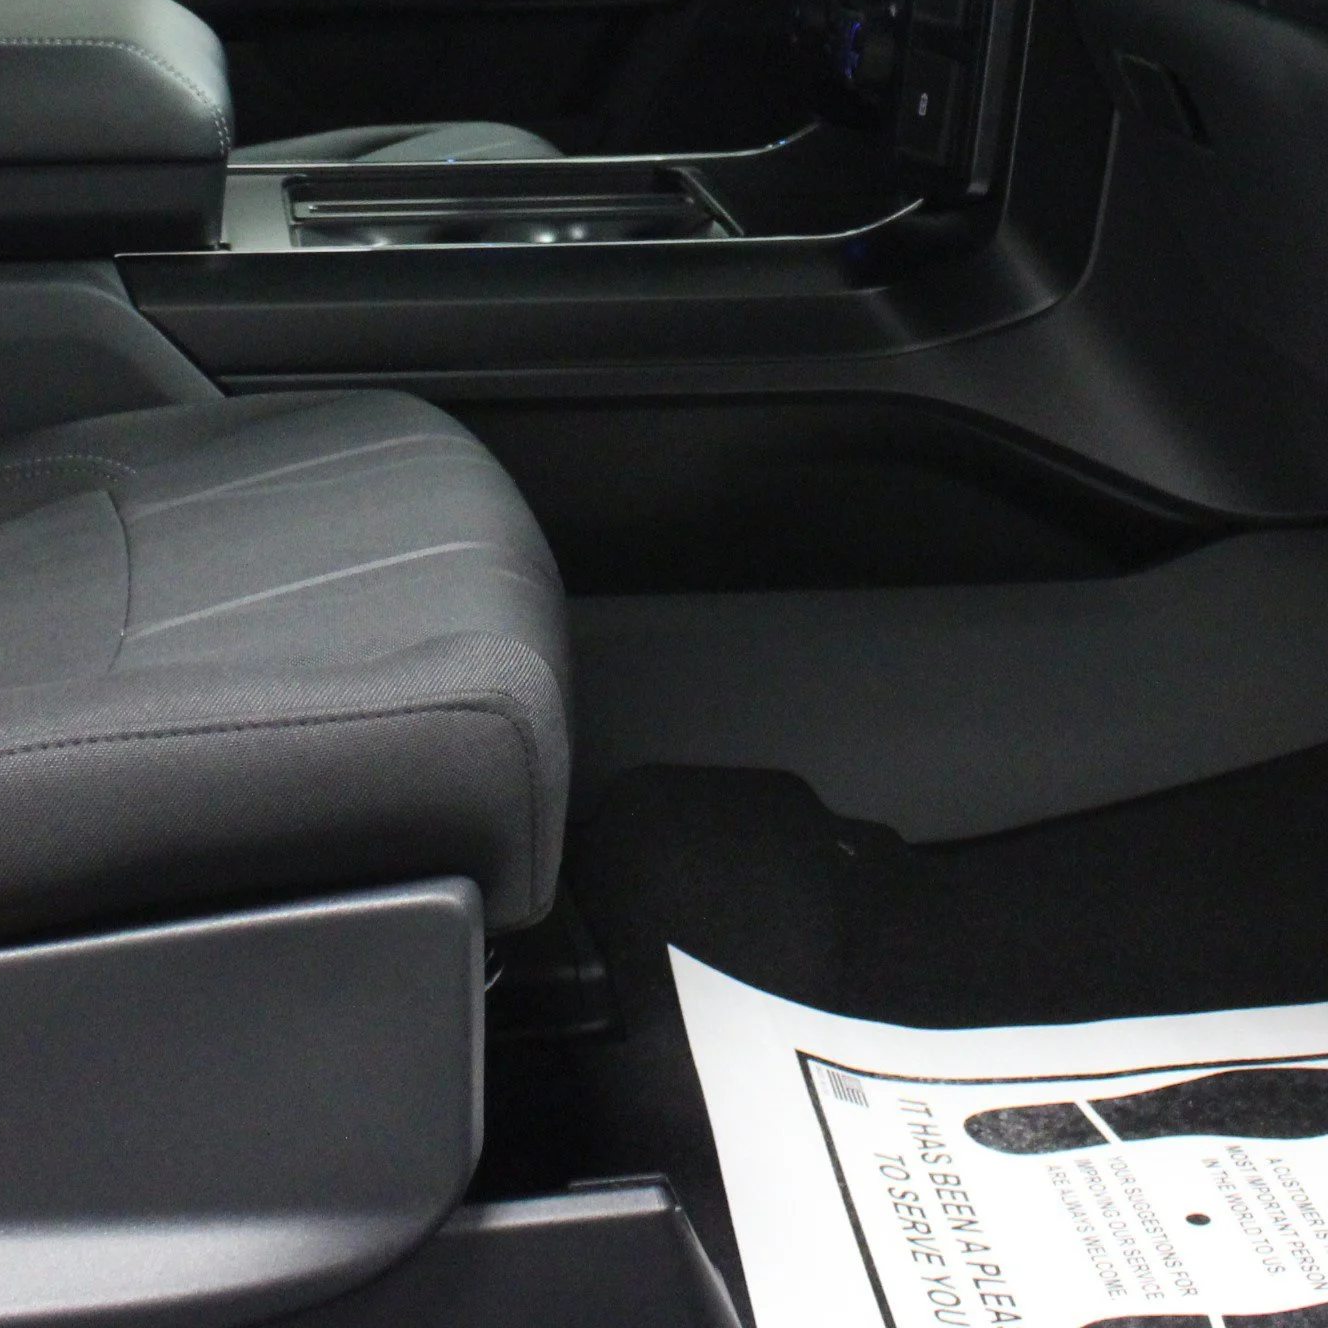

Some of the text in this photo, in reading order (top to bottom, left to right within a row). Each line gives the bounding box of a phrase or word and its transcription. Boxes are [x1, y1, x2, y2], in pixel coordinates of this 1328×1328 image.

[1201, 1157, 1221, 1168] IN
[1213, 1172, 1237, 1192] THE
[1223, 1144, 1255, 1175] MOST
[1247, 1175, 1299, 1240] IMPORTANT
[1265, 1157, 1283, 1165] A
[898, 1098, 1022, 1328] IT HAS BEEN A PLEA
[1044, 1164, 1070, 1187] ARE
[1060, 1189, 1094, 1233] ALWAYS
[1074, 1158, 1165, 1301] IMPROVING OUR SERVICE
[1107, 1156, 1198, 1298] YOUR SUGGESTIONS FOR
[1224, 1193, 1262, 1237] WORLD
[1272, 1167, 1324, 1231] CUSTOMER
[874, 1152, 970, 1326] TO SERVE YOU
[1254, 1238, 1274, 1254] TO
